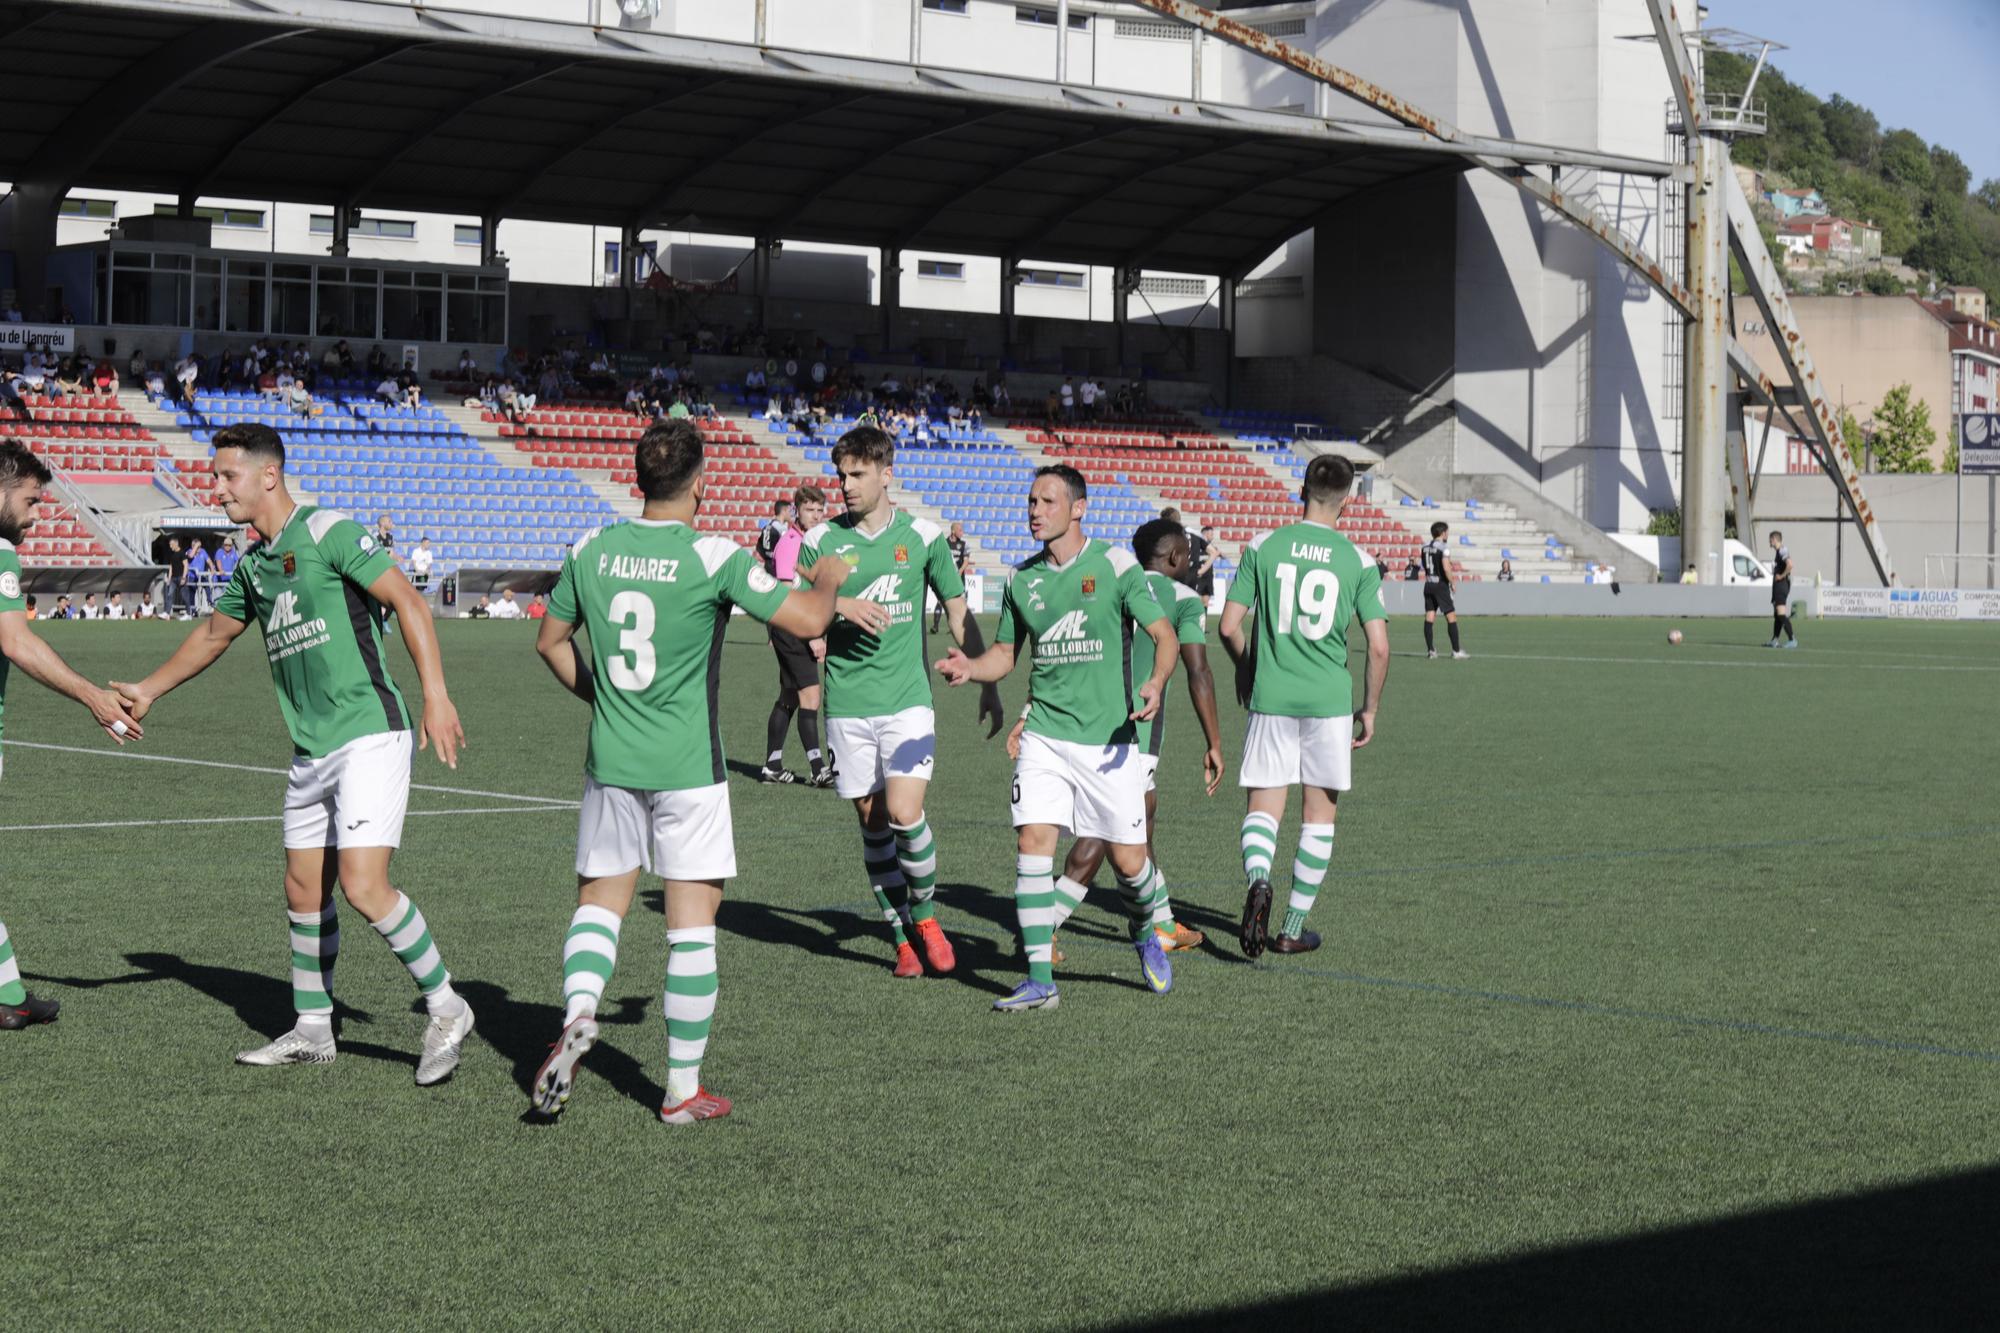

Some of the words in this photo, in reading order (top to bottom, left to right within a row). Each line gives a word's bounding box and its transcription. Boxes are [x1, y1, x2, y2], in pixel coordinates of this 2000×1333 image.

[8, 330, 20, 343] de
[22, 329, 65, 346] Llangréu
[1290, 541, 1333, 563] LAINE
[609, 554, 680, 583] ALVAREZ
[1275, 562, 1340, 641] 19
[1921, 591, 1958, 602] AGUAS
[1889, 603, 1904, 617] DE
[1907, 603, 1957, 617] LANGREO
[608, 590, 657, 691] 3
